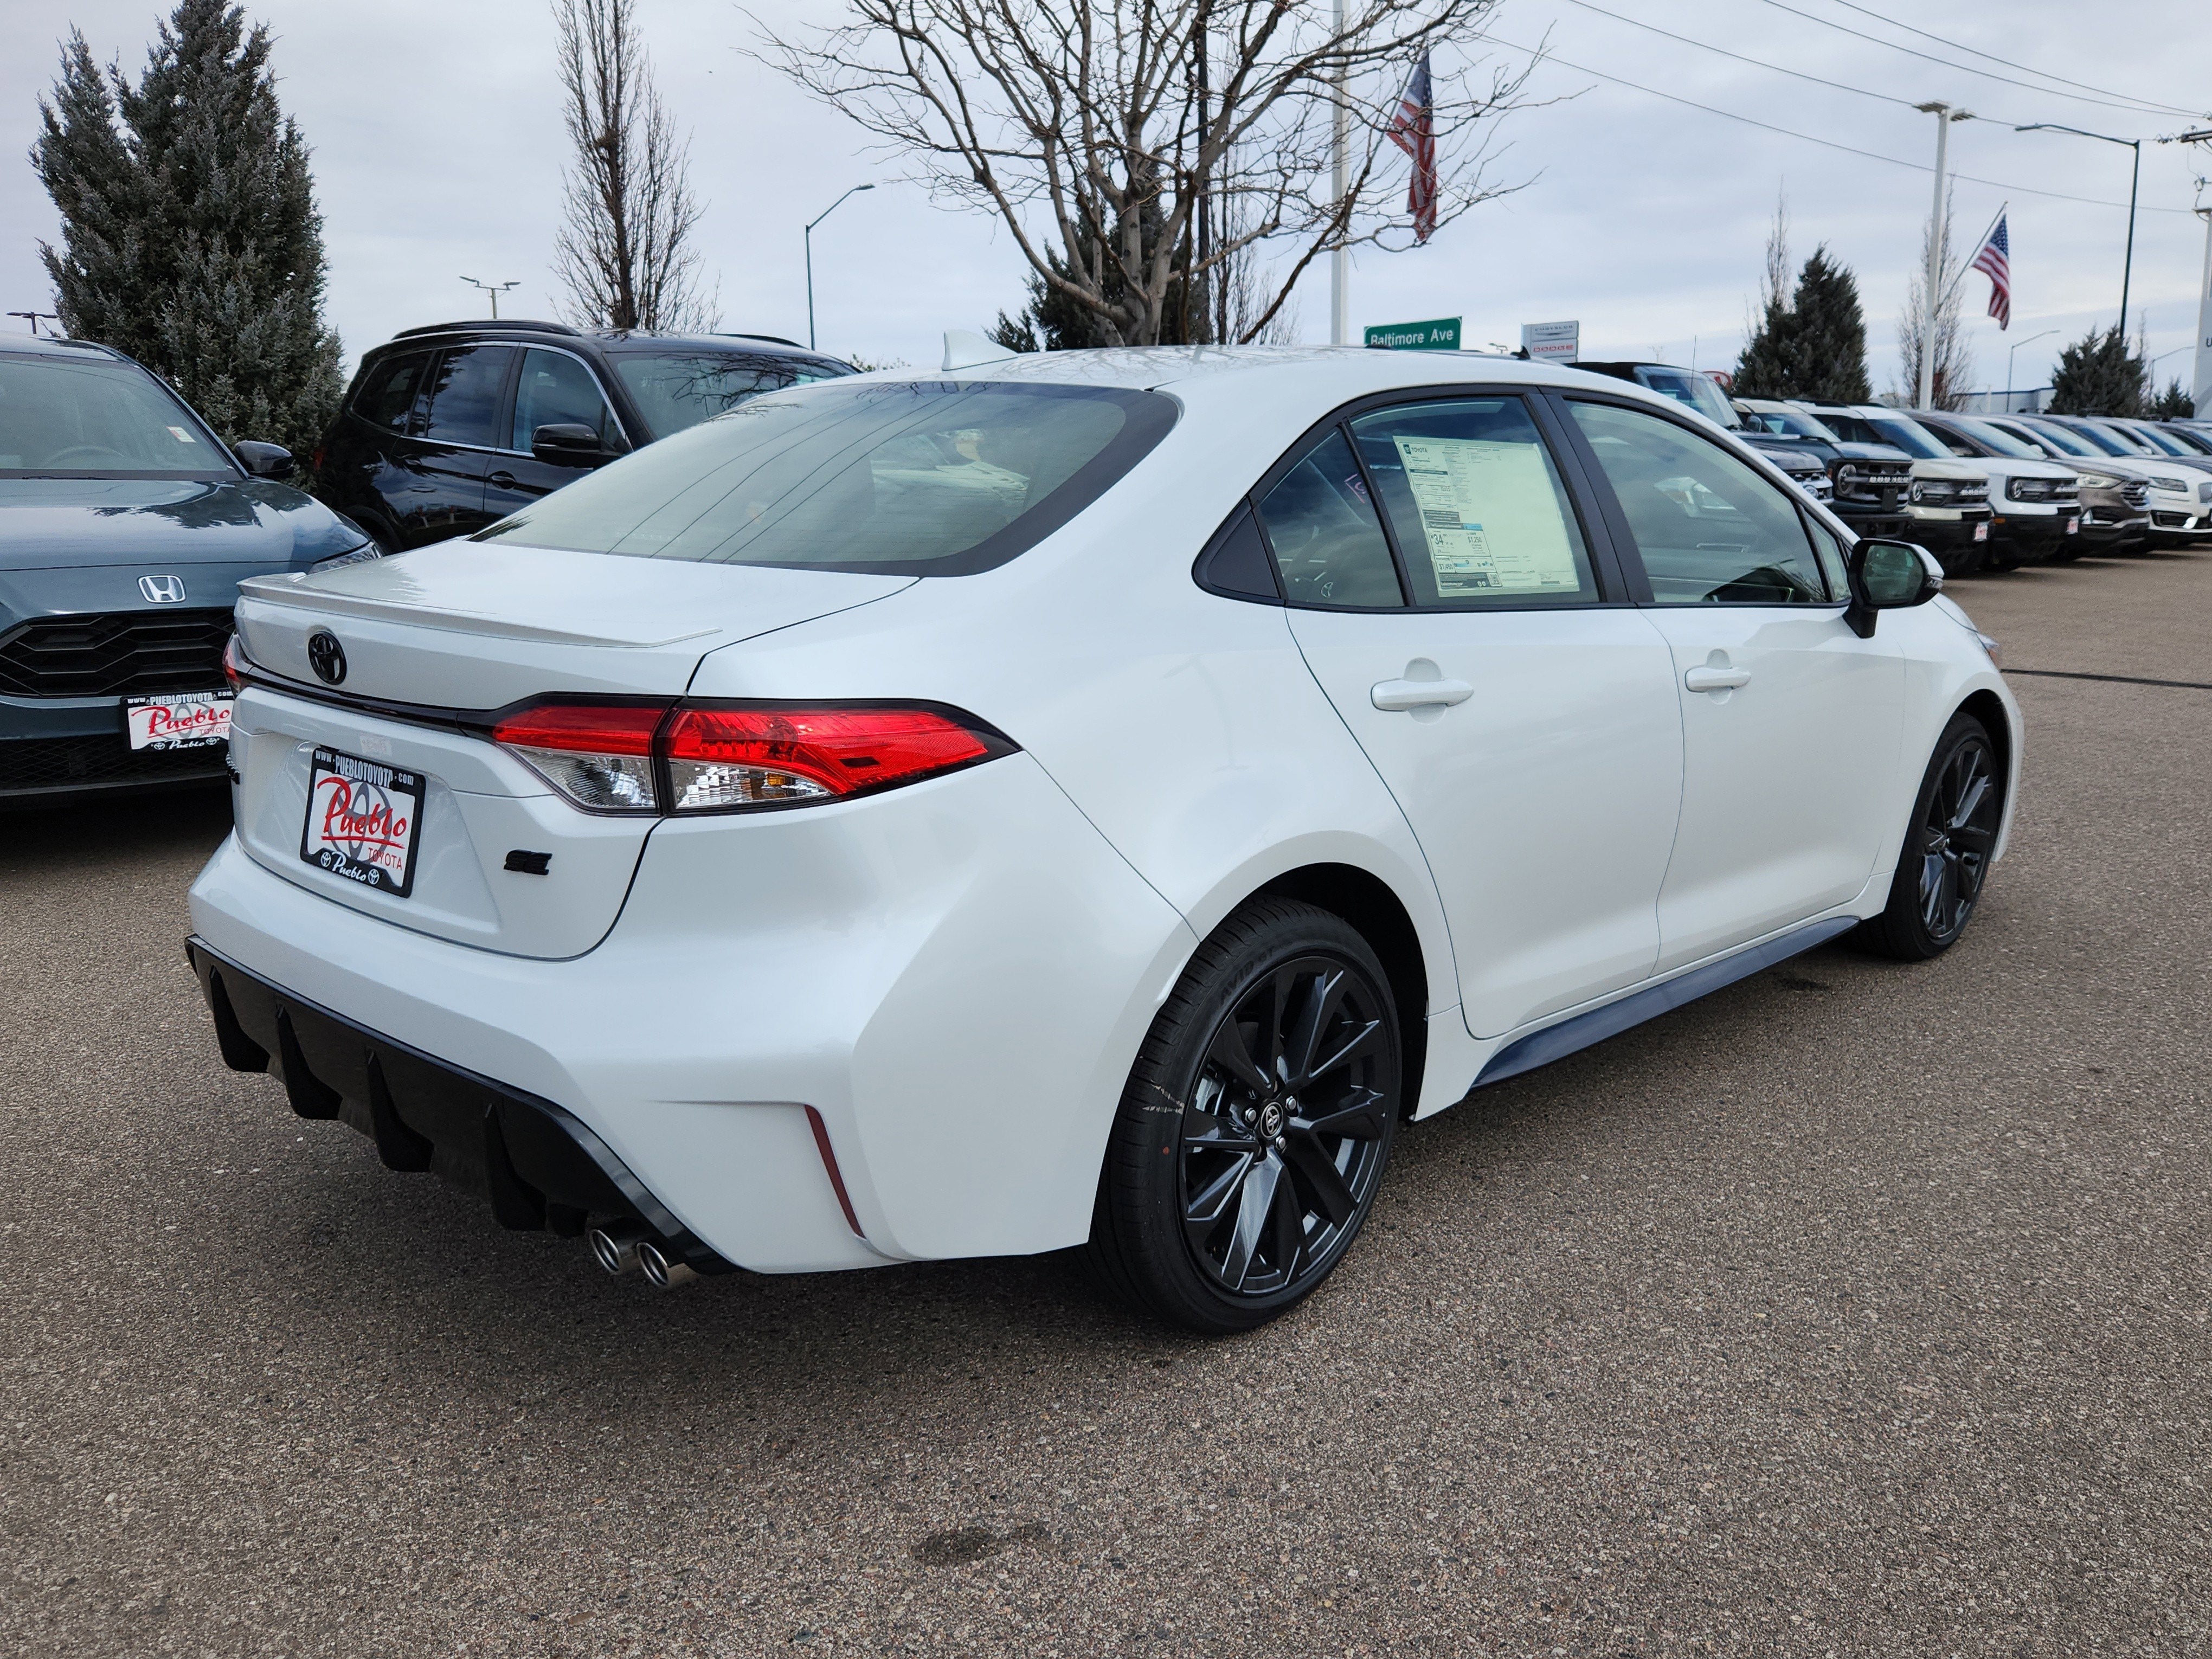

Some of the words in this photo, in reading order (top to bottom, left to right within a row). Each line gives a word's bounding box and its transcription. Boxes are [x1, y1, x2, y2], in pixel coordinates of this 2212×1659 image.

[1370, 332, 1425, 346] Baltimore
[1430, 328, 1454, 342] Ave
[131, 706, 230, 735] Pueblo
[164, 739, 205, 750] Pueblo
[317, 776, 407, 837] Pueblo
[331, 851, 366, 882] Pueblo
[368, 847, 402, 871] TOYOTA
[503, 849, 553, 876] SE
